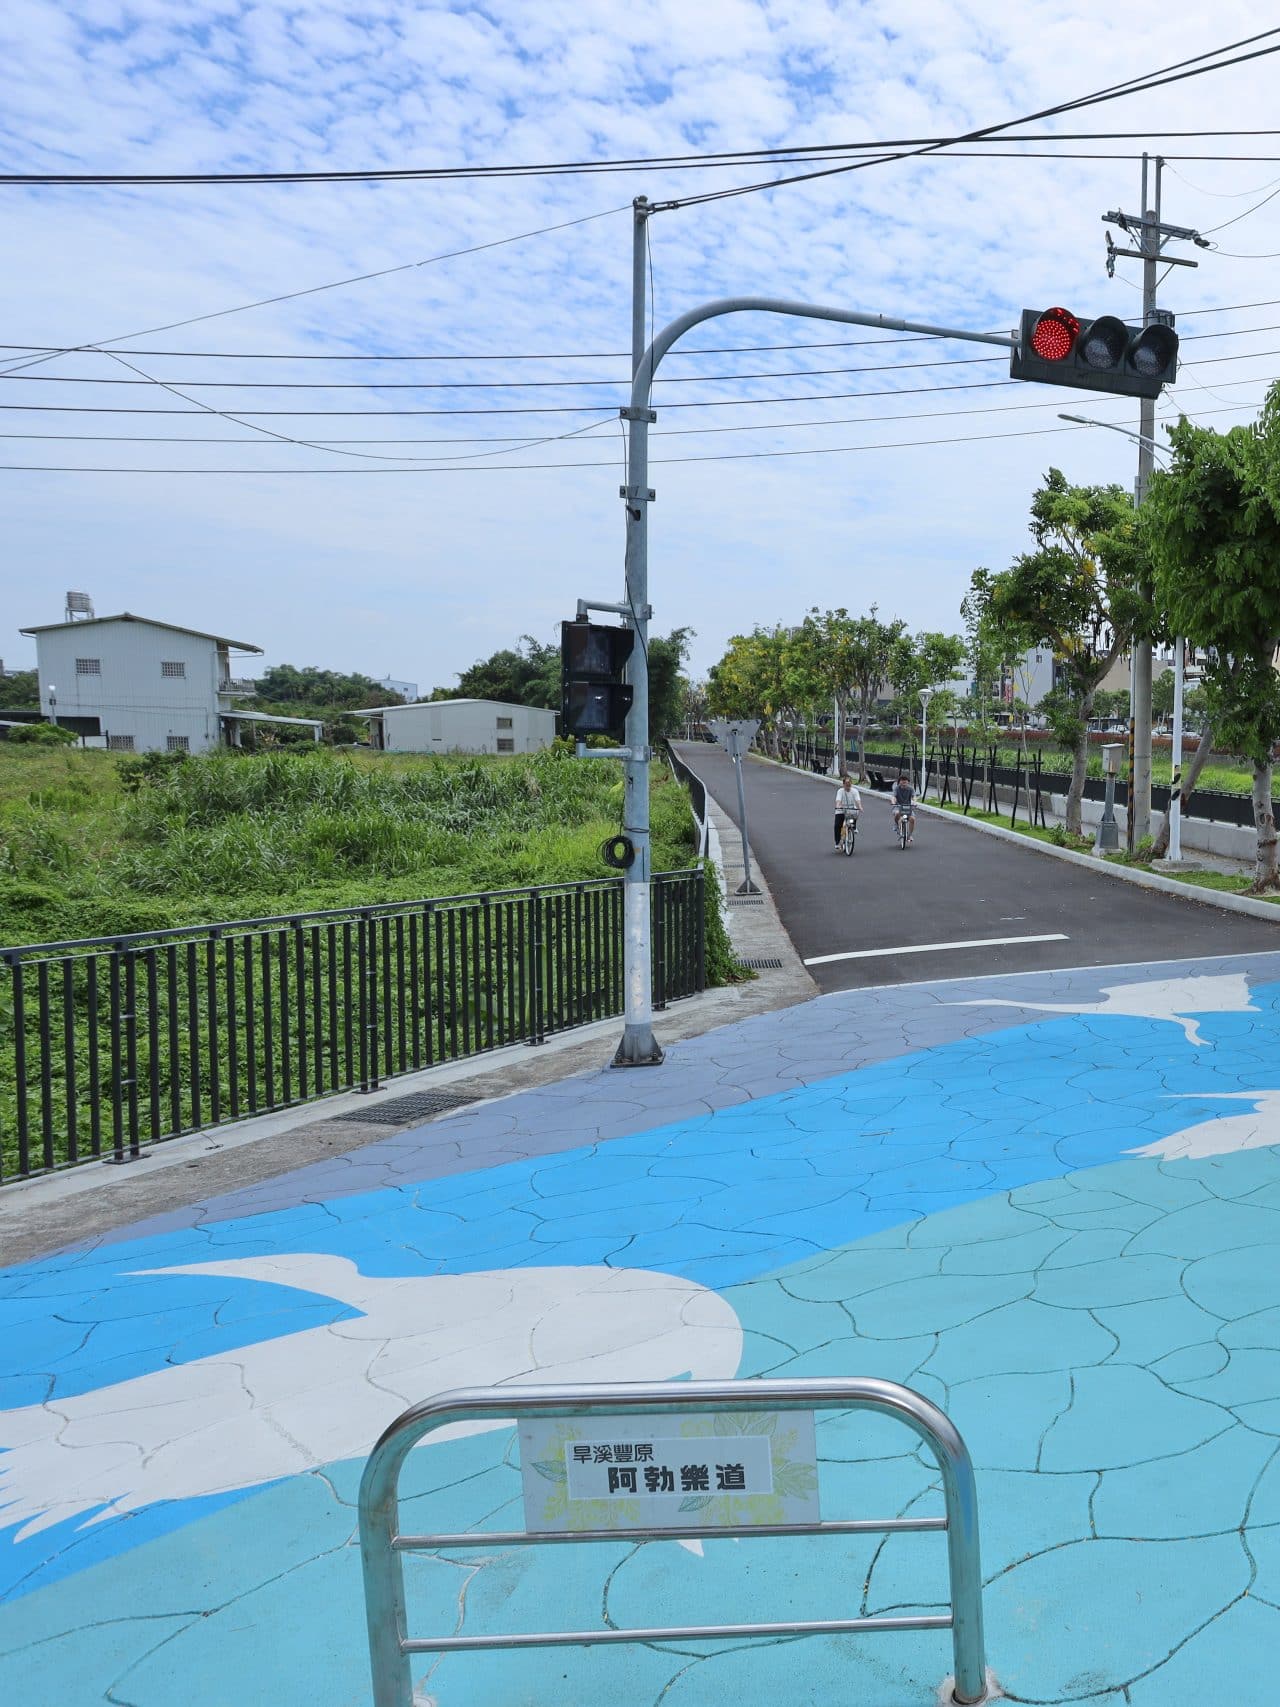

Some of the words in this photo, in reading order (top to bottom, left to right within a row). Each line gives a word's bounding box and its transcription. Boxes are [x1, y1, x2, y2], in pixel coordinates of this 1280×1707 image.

[572, 1443, 655, 1464] 旱溪豐原
[607, 1463, 746, 1494] 阿勃樂道
